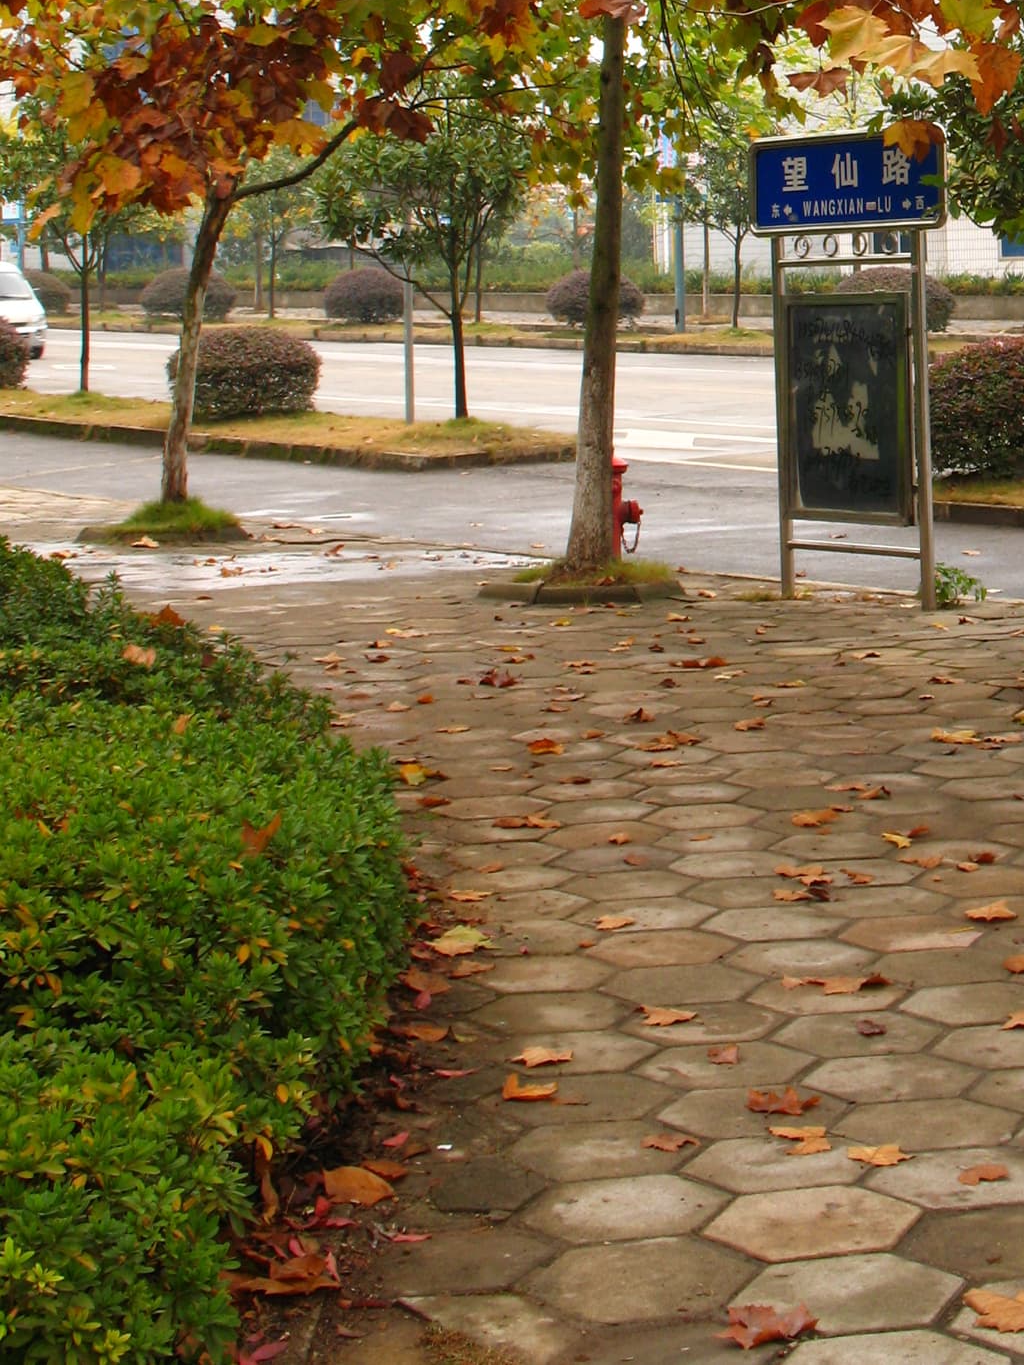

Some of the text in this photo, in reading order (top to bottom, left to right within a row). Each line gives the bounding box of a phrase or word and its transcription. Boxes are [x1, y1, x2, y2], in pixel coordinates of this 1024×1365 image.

[782, 148, 911, 192] 望仙路
[771, 203, 780, 219] 东
[802, 195, 892, 217] WANGXIAN LU
[915, 195, 925, 210] 西
